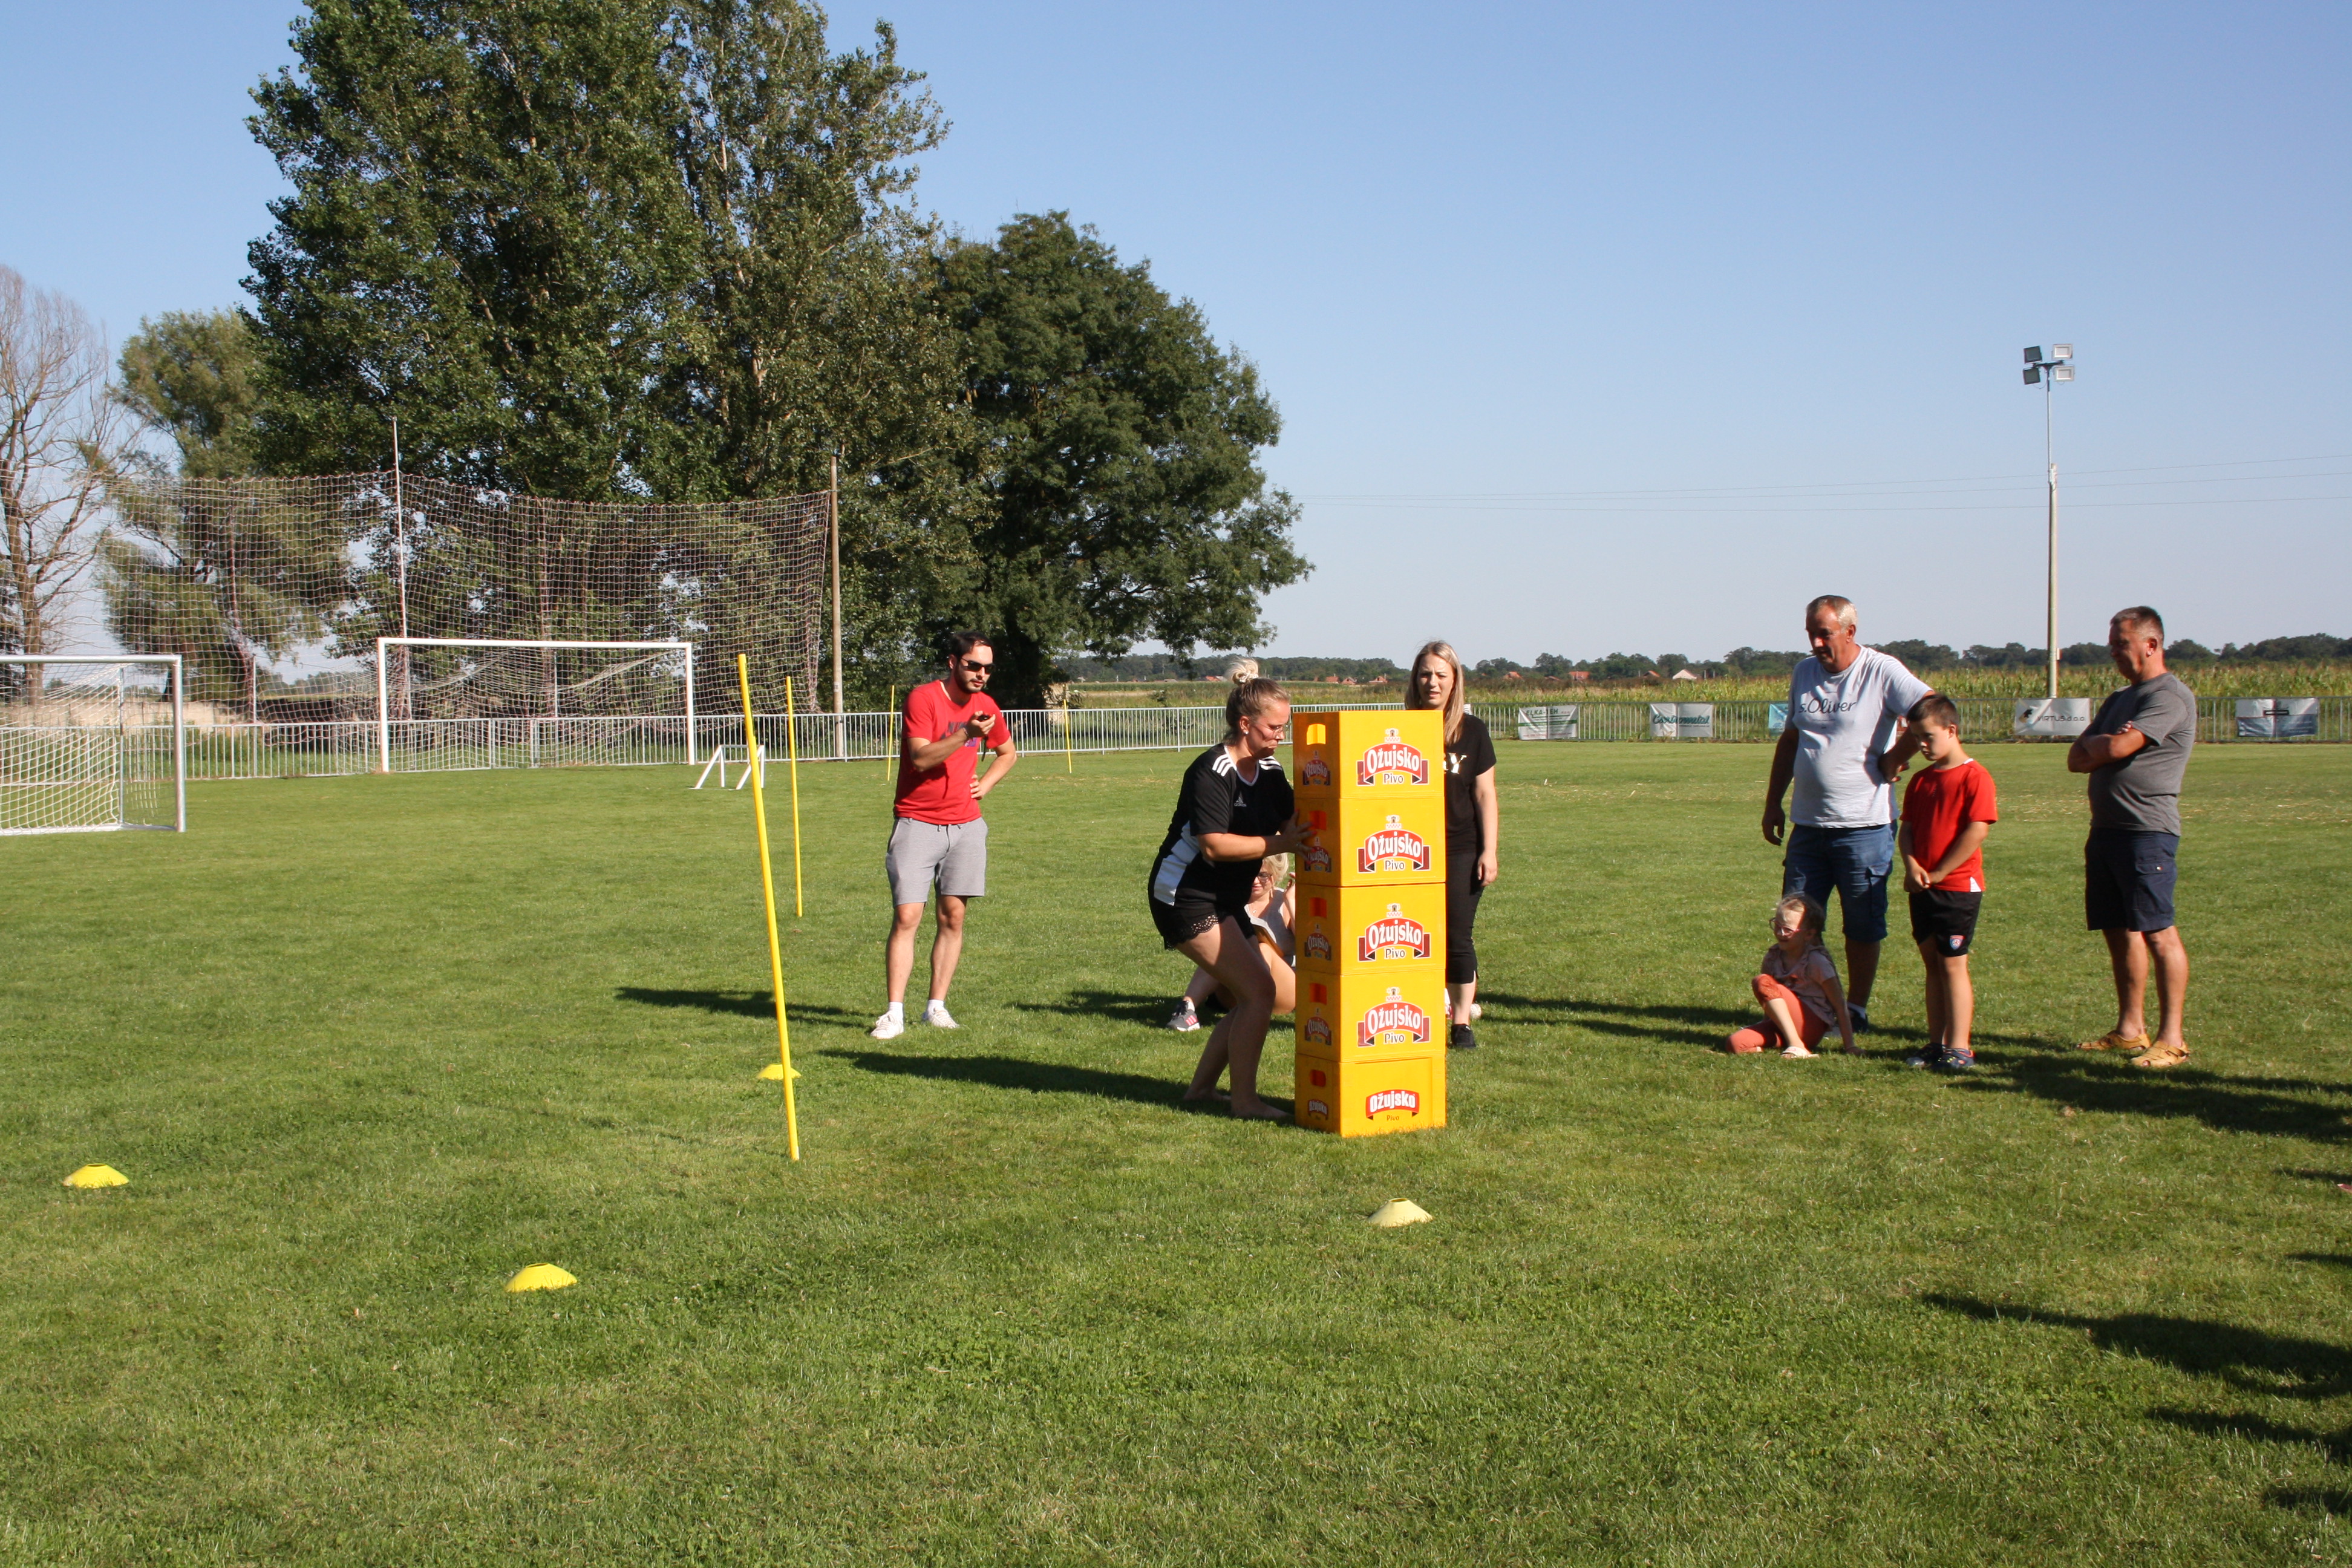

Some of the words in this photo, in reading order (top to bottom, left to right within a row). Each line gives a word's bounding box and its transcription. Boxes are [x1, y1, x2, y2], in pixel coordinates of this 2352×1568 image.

[1798, 697, 1857, 713] s.Oliver
[1367, 745, 1420, 773] Ožujsko
[1383, 773, 1403, 783] Pivo
[1368, 831, 1421, 861] Ožujsko
[1385, 860, 1405, 871] Pivo
[1368, 920, 1422, 949] Ožujsko
[1385, 948, 1405, 959] Pivo
[1368, 1004, 1420, 1034] Ožujsko
[1385, 1033, 1404, 1044] Pivo
[1370, 1091, 1416, 1112] Ožujsko
